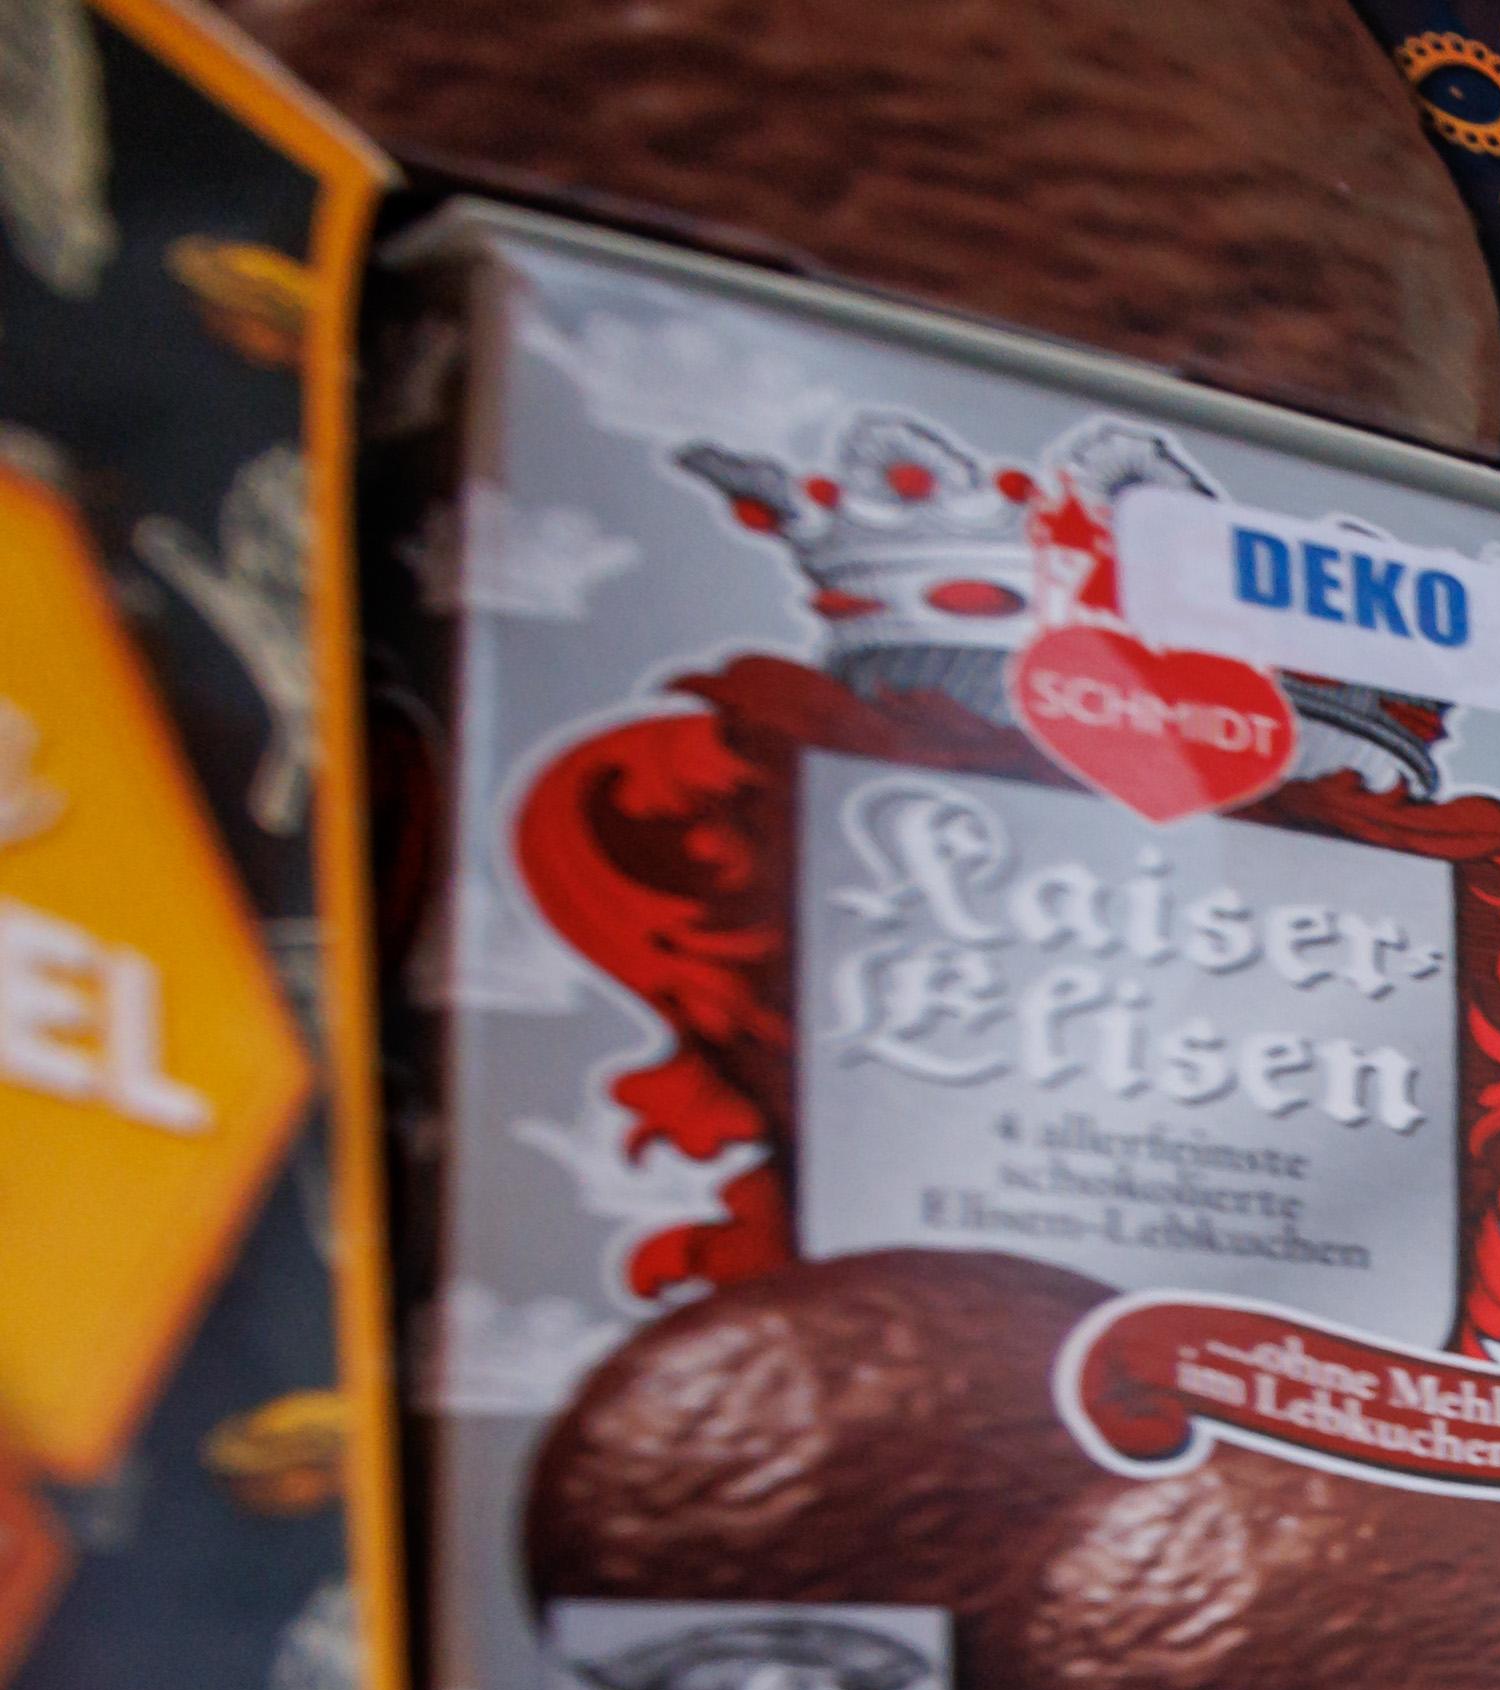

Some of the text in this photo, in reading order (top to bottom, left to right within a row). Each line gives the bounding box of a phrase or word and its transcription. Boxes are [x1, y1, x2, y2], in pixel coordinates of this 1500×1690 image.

[1231, 525, 1471, 650] DEKO
[1032, 670, 1280, 757] SCHMIDT
[825, 945, 1429, 1135] Elisen
[1176, 1345, 1247, 1406] im
